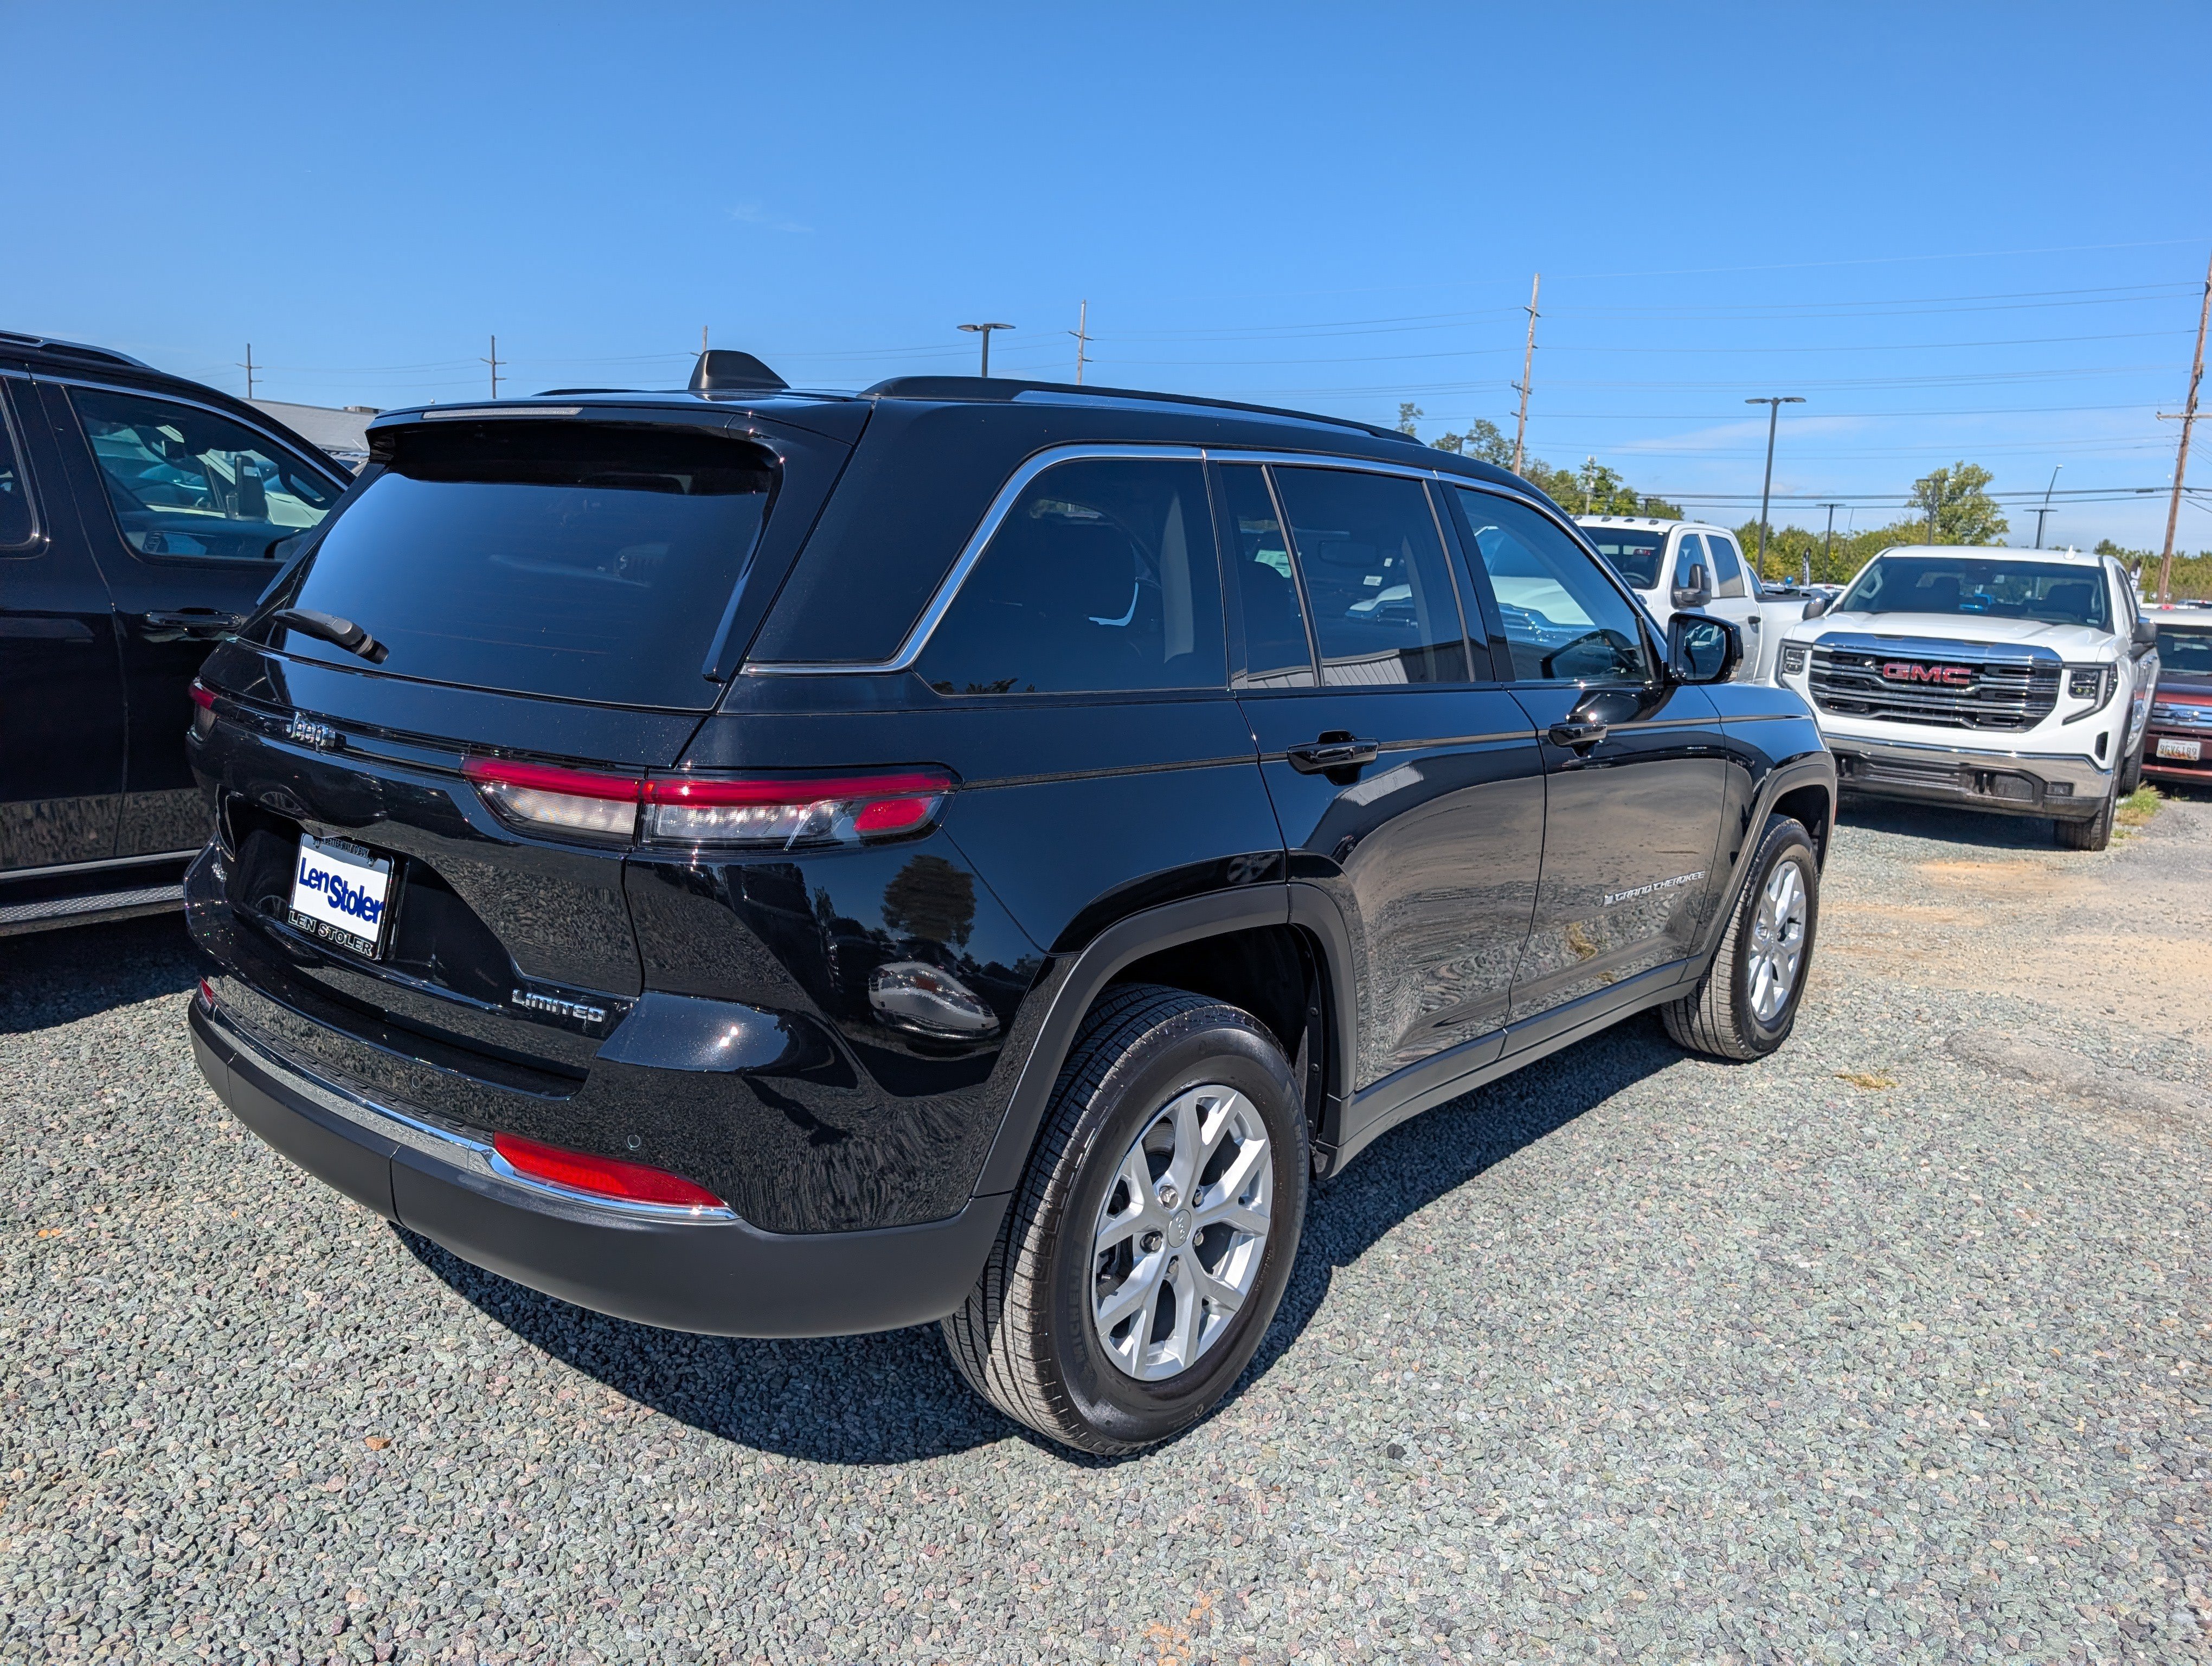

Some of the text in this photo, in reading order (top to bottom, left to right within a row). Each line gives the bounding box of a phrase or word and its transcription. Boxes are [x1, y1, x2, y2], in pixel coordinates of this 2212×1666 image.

[1883, 663, 1972, 684] GMC
[286, 712, 332, 752] Jeep
[325, 837, 342, 850] BETTER
[341, 841, 351, 852] WAY
[350, 844, 358, 855] TO
[358, 846, 369, 857] BUY
[1615, 871, 1706, 901] GRAND CHEROKEE
[288, 910, 373, 957] LEN STOLER
[512, 989, 606, 1022] LIMITED
